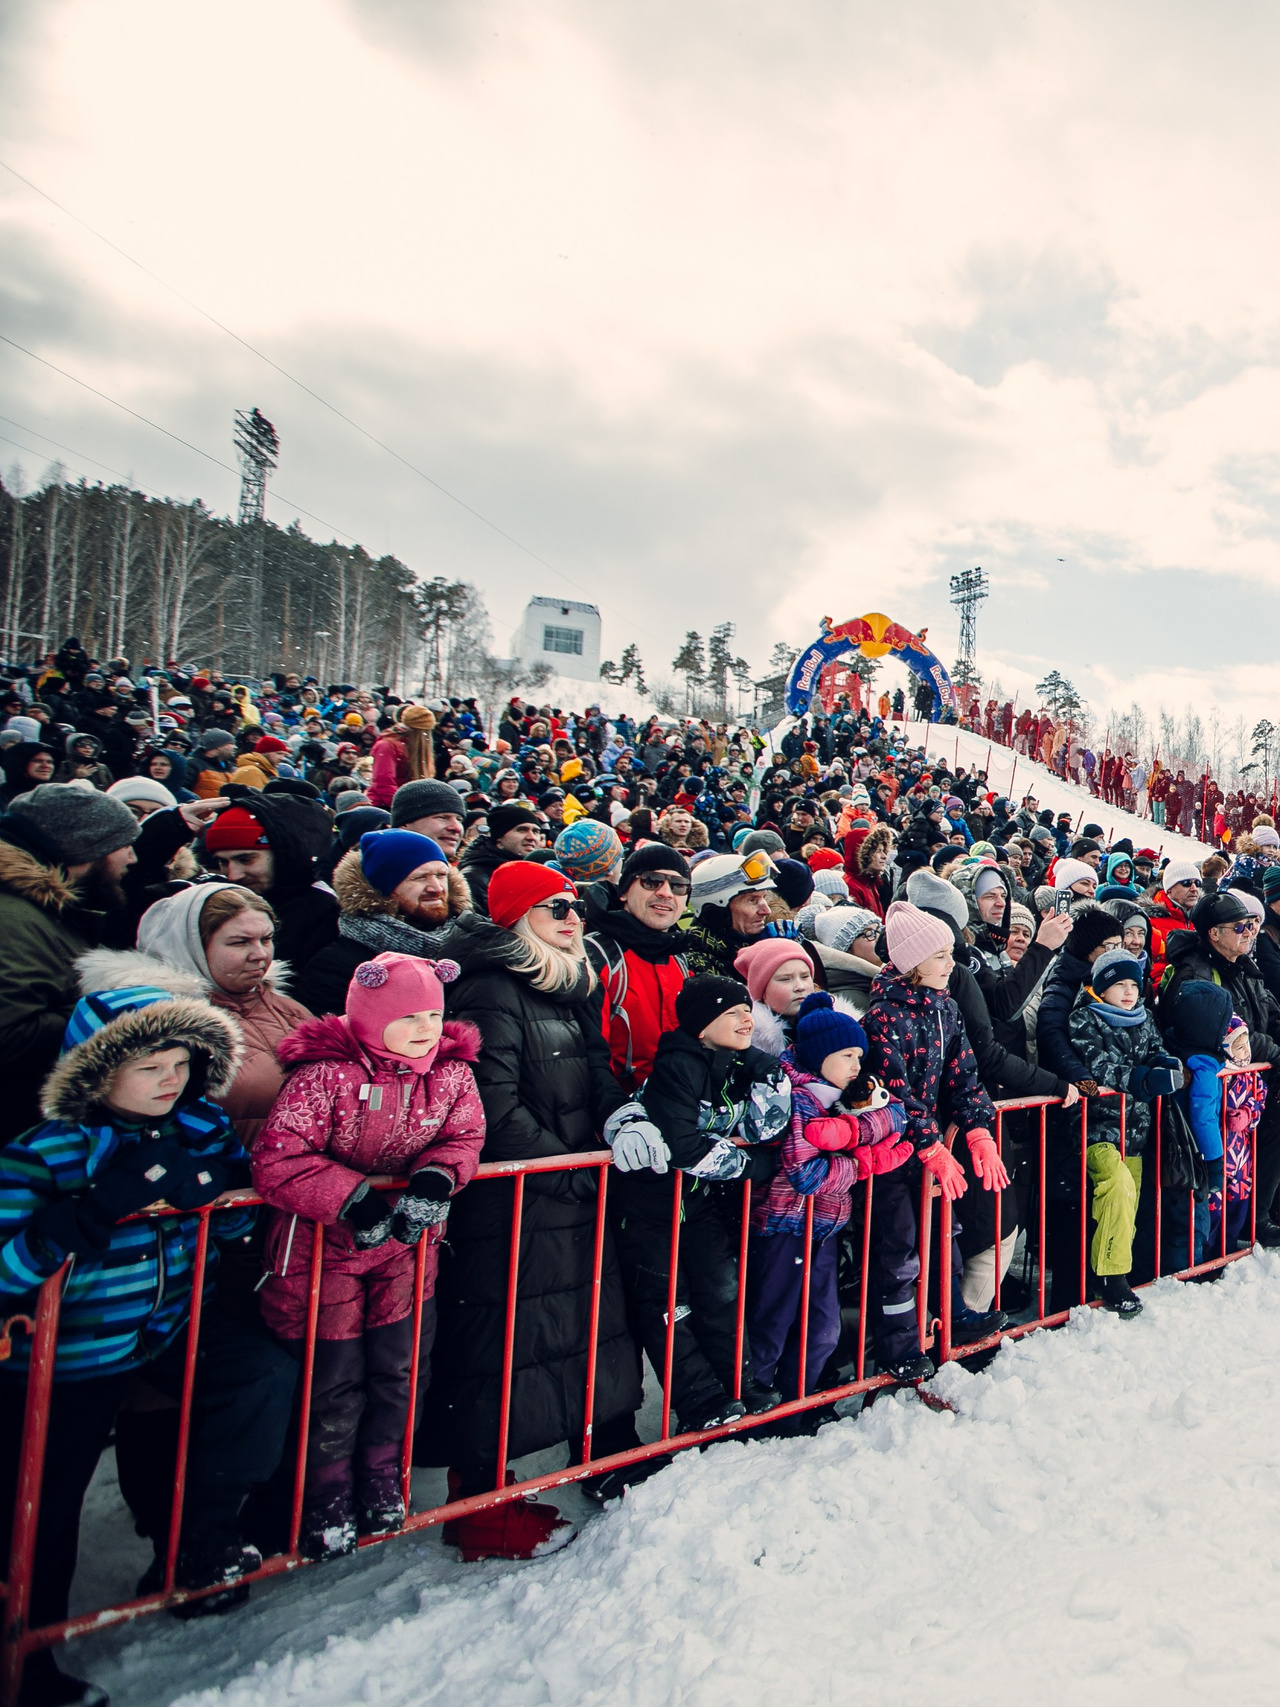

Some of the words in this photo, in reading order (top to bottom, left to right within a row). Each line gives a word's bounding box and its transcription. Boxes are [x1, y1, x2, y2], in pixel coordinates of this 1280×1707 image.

[804, 649, 824, 670] Bull
[797, 667, 814, 690] Red
[930, 665, 947, 686] Red
